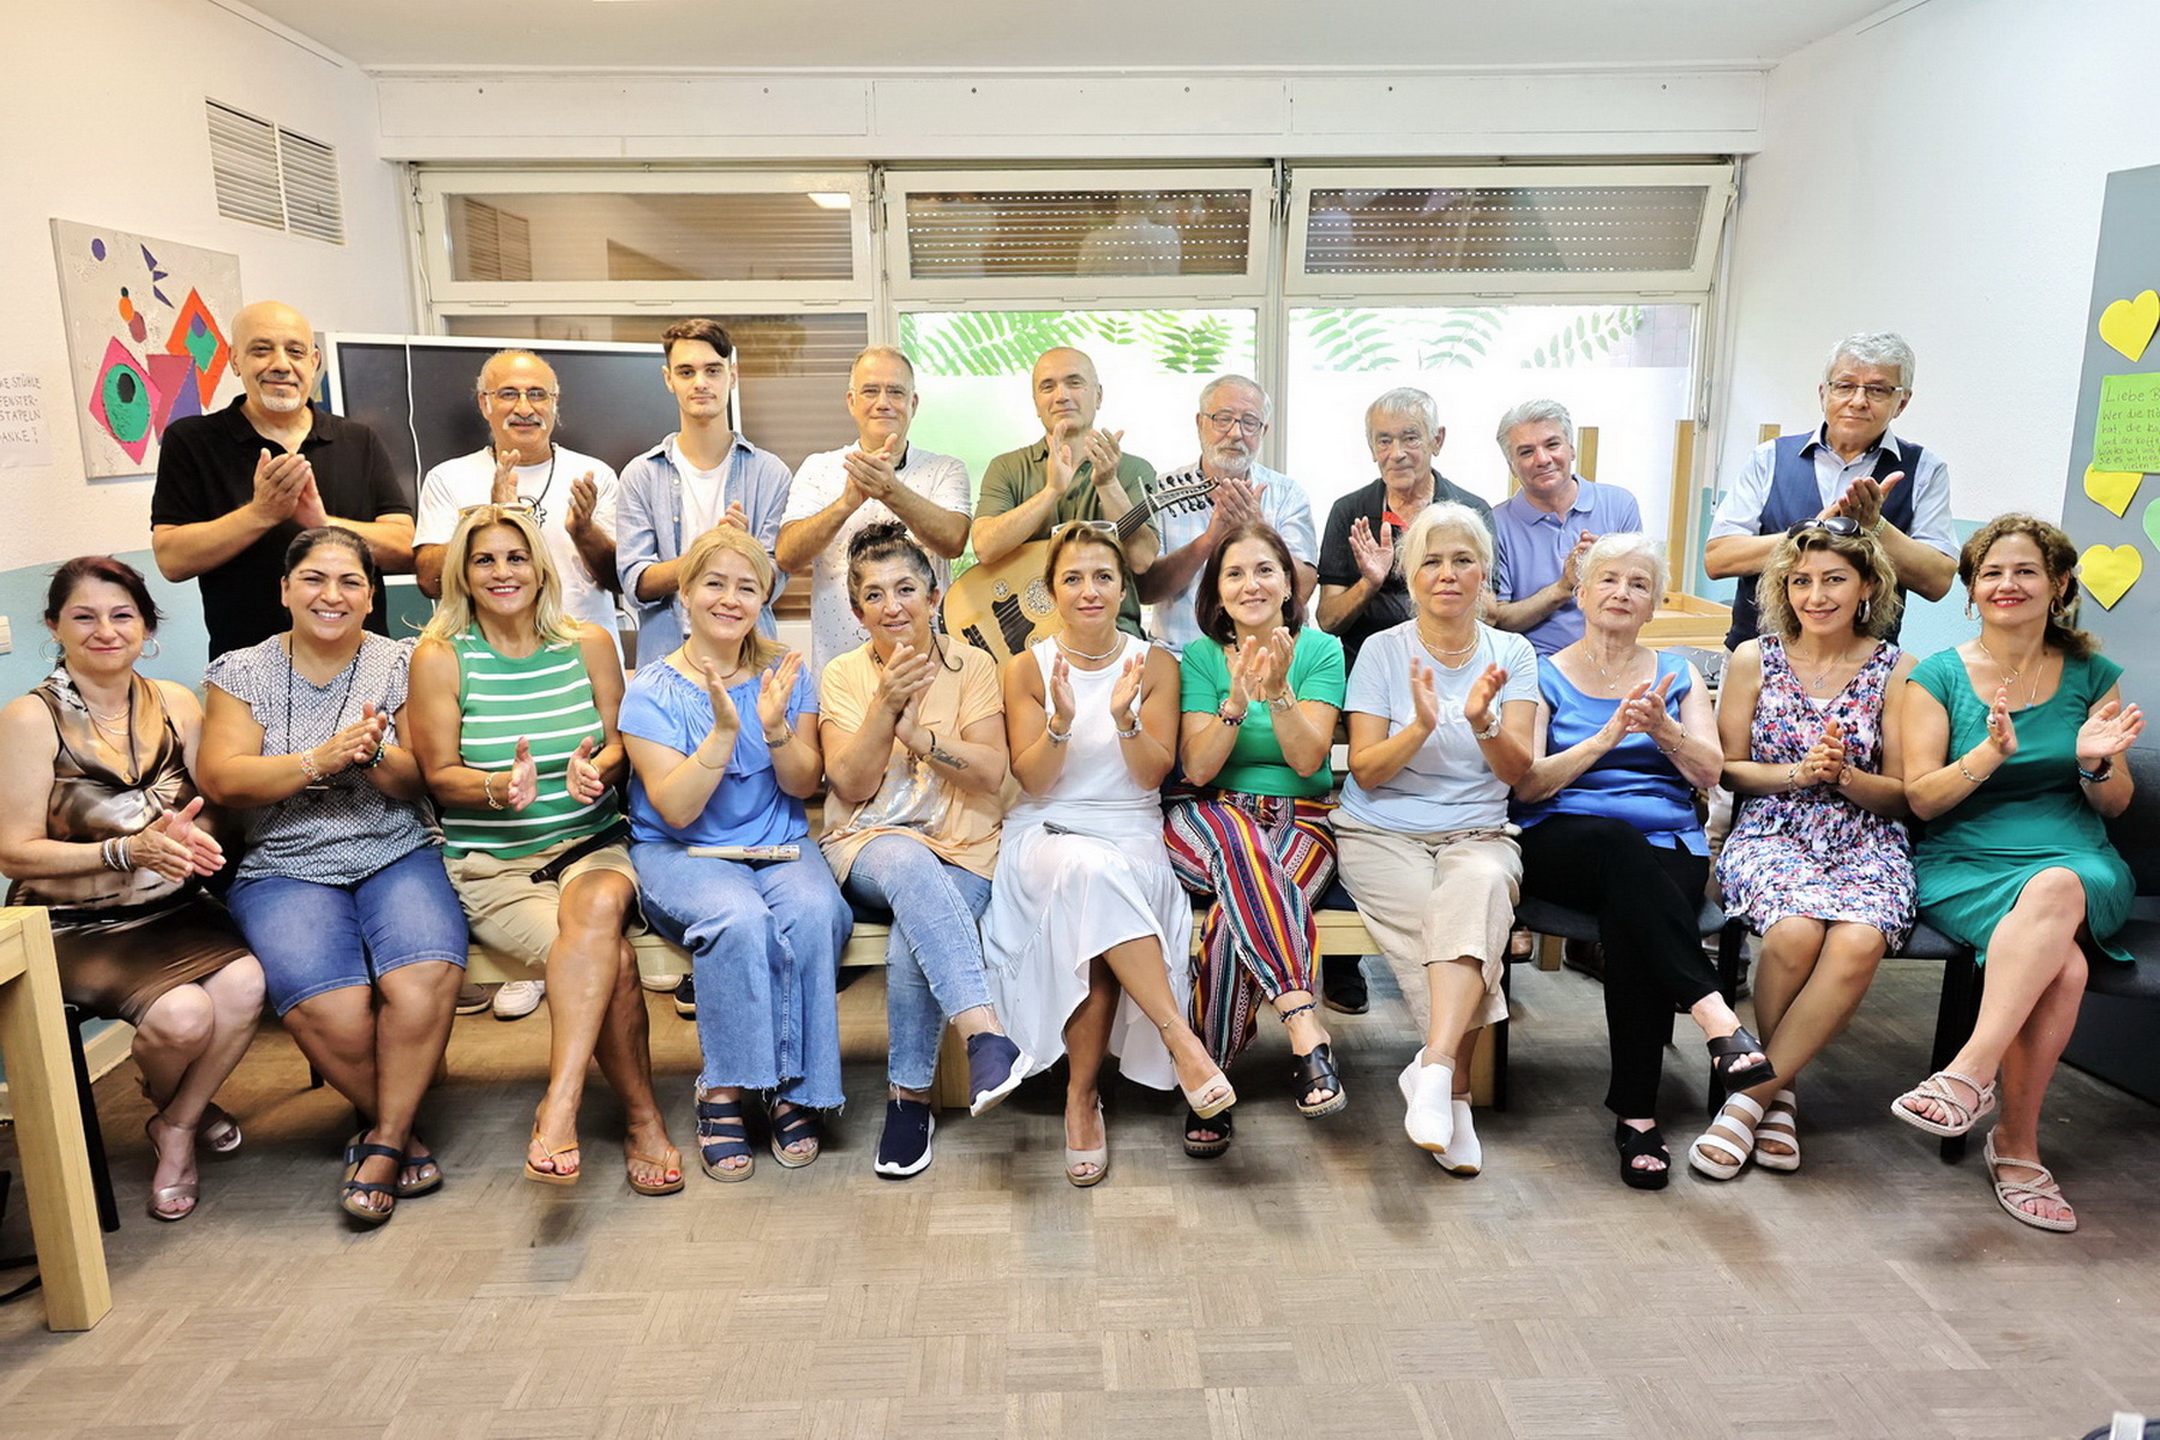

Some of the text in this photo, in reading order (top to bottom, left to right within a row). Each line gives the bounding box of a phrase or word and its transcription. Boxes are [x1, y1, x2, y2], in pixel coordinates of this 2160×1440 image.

[2105, 384, 2145, 403] Liebe
[2102, 409, 2123, 421] Wer
[2127, 408, 2143, 419] die
[2126, 423, 2142, 433] die
